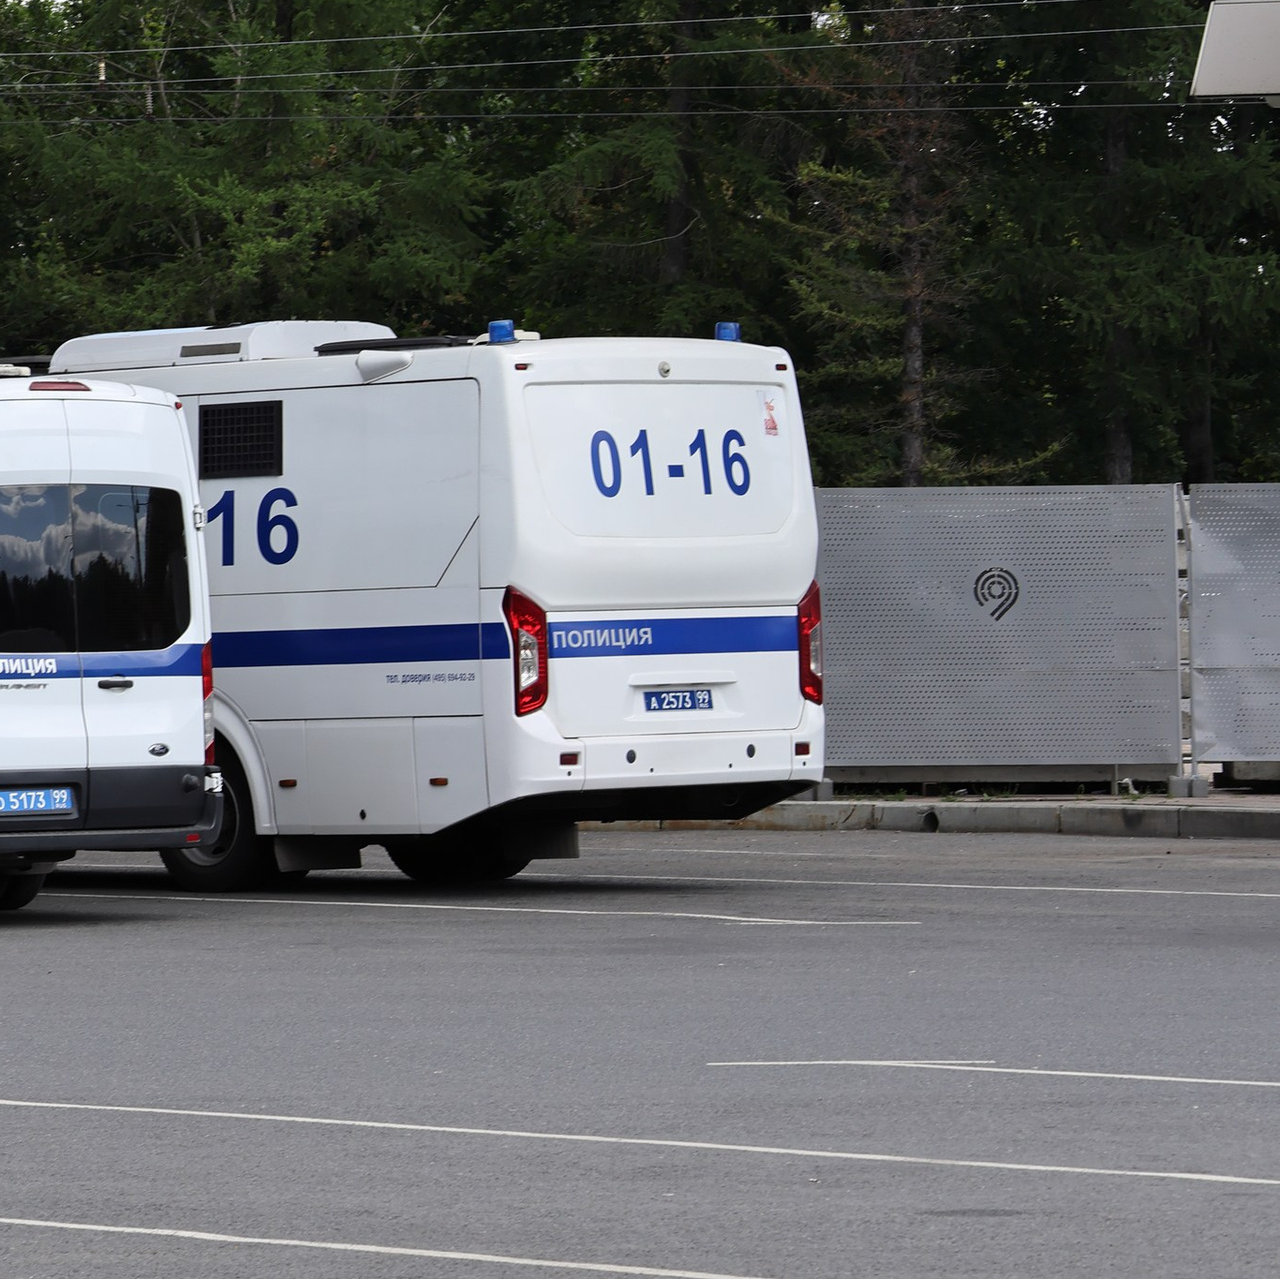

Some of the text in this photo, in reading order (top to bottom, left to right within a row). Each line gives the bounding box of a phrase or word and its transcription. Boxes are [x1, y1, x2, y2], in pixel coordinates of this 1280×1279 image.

[590, 428, 751, 498] 01-16
[207, 486, 300, 567] 16
[552, 627, 653, 649] ПОЛИЦИЯ
[660, 692, 692, 710] 2573
[696, 690, 710, 704] 99
[8, 791, 47, 810] 5173
[52, 789, 68, 803] 99
